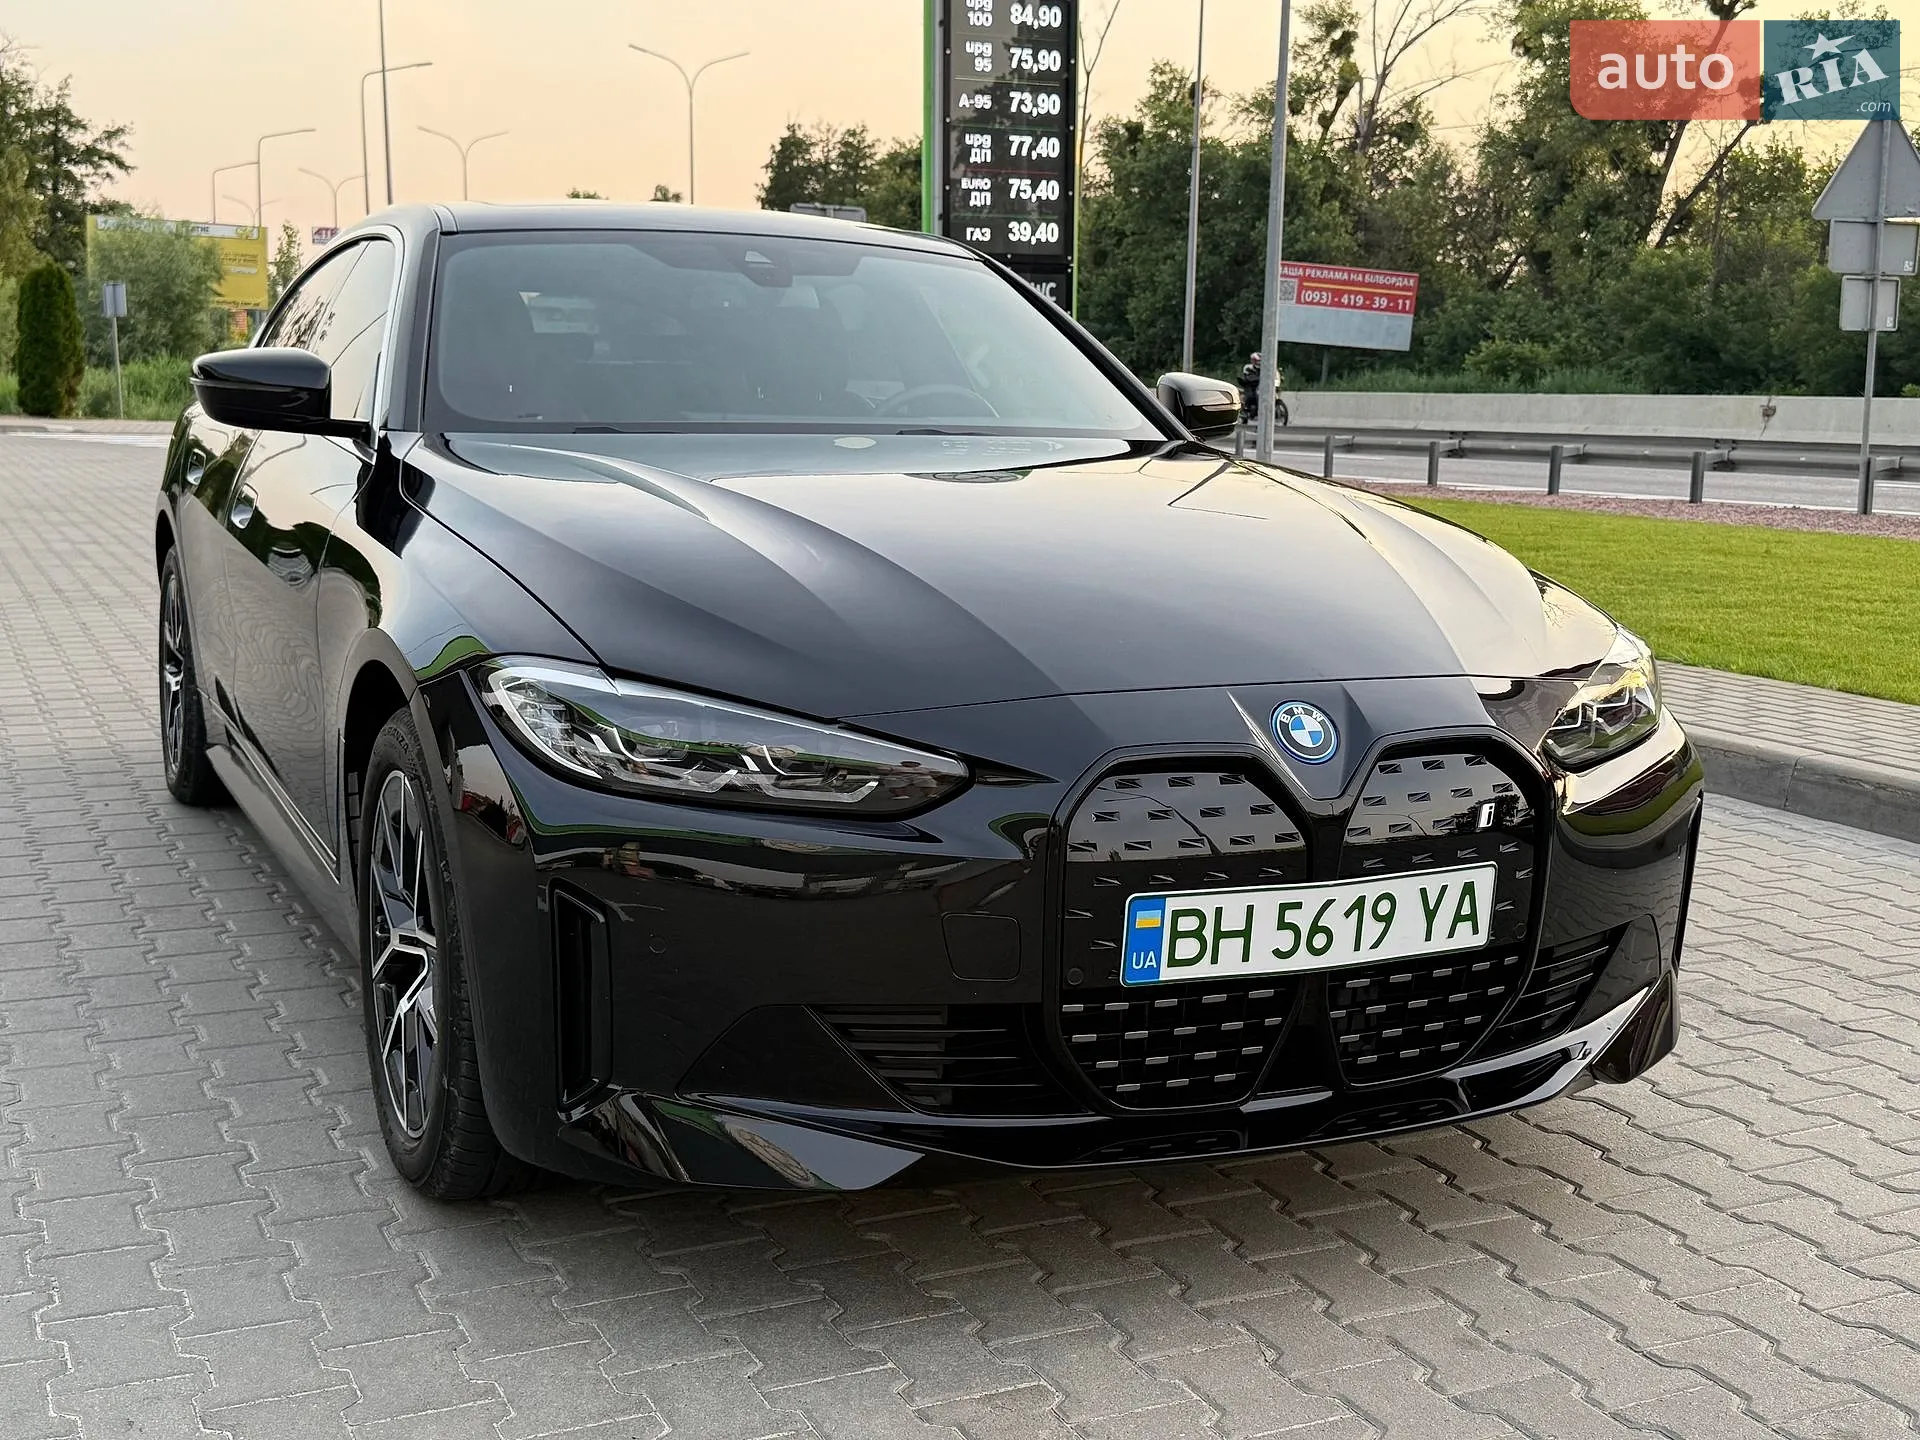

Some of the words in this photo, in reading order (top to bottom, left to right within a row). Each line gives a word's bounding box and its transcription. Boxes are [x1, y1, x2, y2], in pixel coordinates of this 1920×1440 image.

[965, 0, 993, 12] upg
[967, 11, 993, 27] 100
[1010, 2, 1062, 30] 84,90
[965, 40, 993, 57] upg
[974, 56, 993, 73] 95
[1009, 47, 1062, 74] 75,90
[958, 93, 993, 110] А-95
[1009, 91, 1061, 118] 73,90
[965, 133, 992, 149] upg
[1008, 135, 1061, 161] 77,40
[969, 148, 992, 164] ДП
[960, 178, 992, 191] EURO
[1008, 178, 1060, 204] 75,40
[969, 190, 992, 207] ДП
[966, 227, 992, 242] ГАЗ
[1008, 221, 1060, 246] 39,40
[1305, 267, 1348, 281] РЕКЛАМА
[1350, 272, 1363, 282] НА
[1364, 274, 1414, 287] БІЛБОРДАХ
[1280, 706, 1324, 724] BMW
[1167, 904, 1255, 968] BH
[1271, 891, 1398, 959] 5619
[1419, 881, 1480, 942] YA
[1132, 951, 1157, 969] UA
